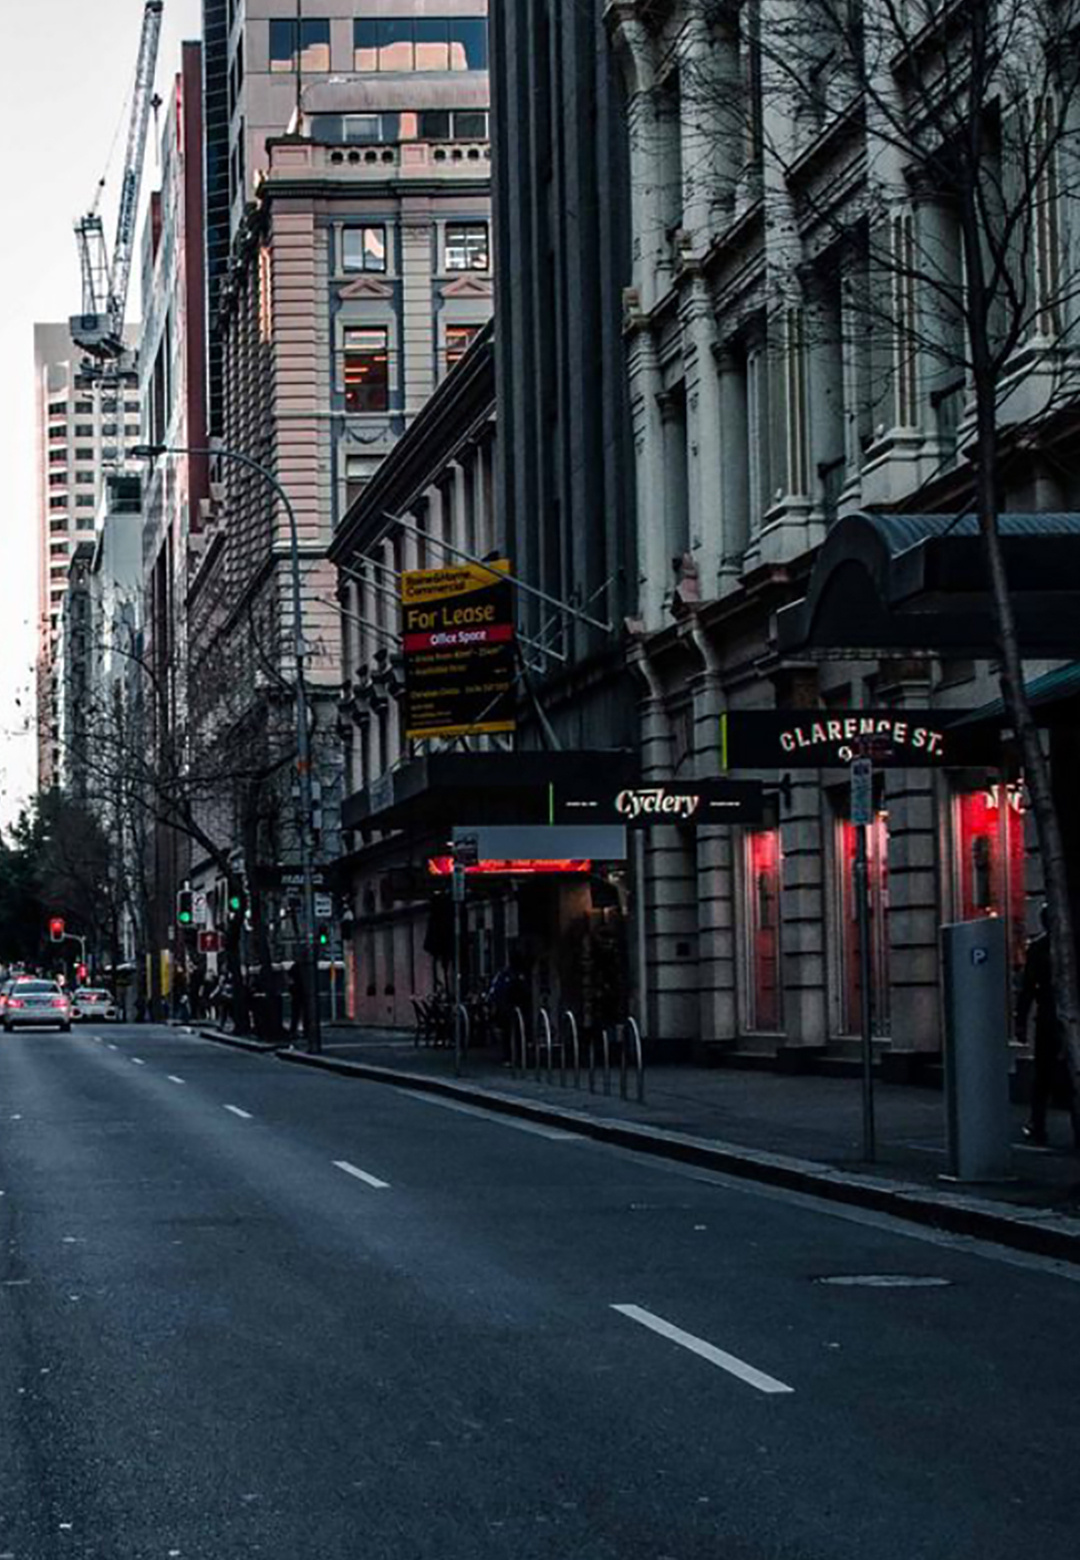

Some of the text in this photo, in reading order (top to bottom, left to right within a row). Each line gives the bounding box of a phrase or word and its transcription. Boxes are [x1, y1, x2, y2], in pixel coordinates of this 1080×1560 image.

[407, 604, 495, 630] For Lease
[429, 630, 487, 646] Office Space
[779, 717, 944, 757] CLARENCE ST.
[614, 787, 700, 819] Cyclery
[973, 949, 987, 964] P
